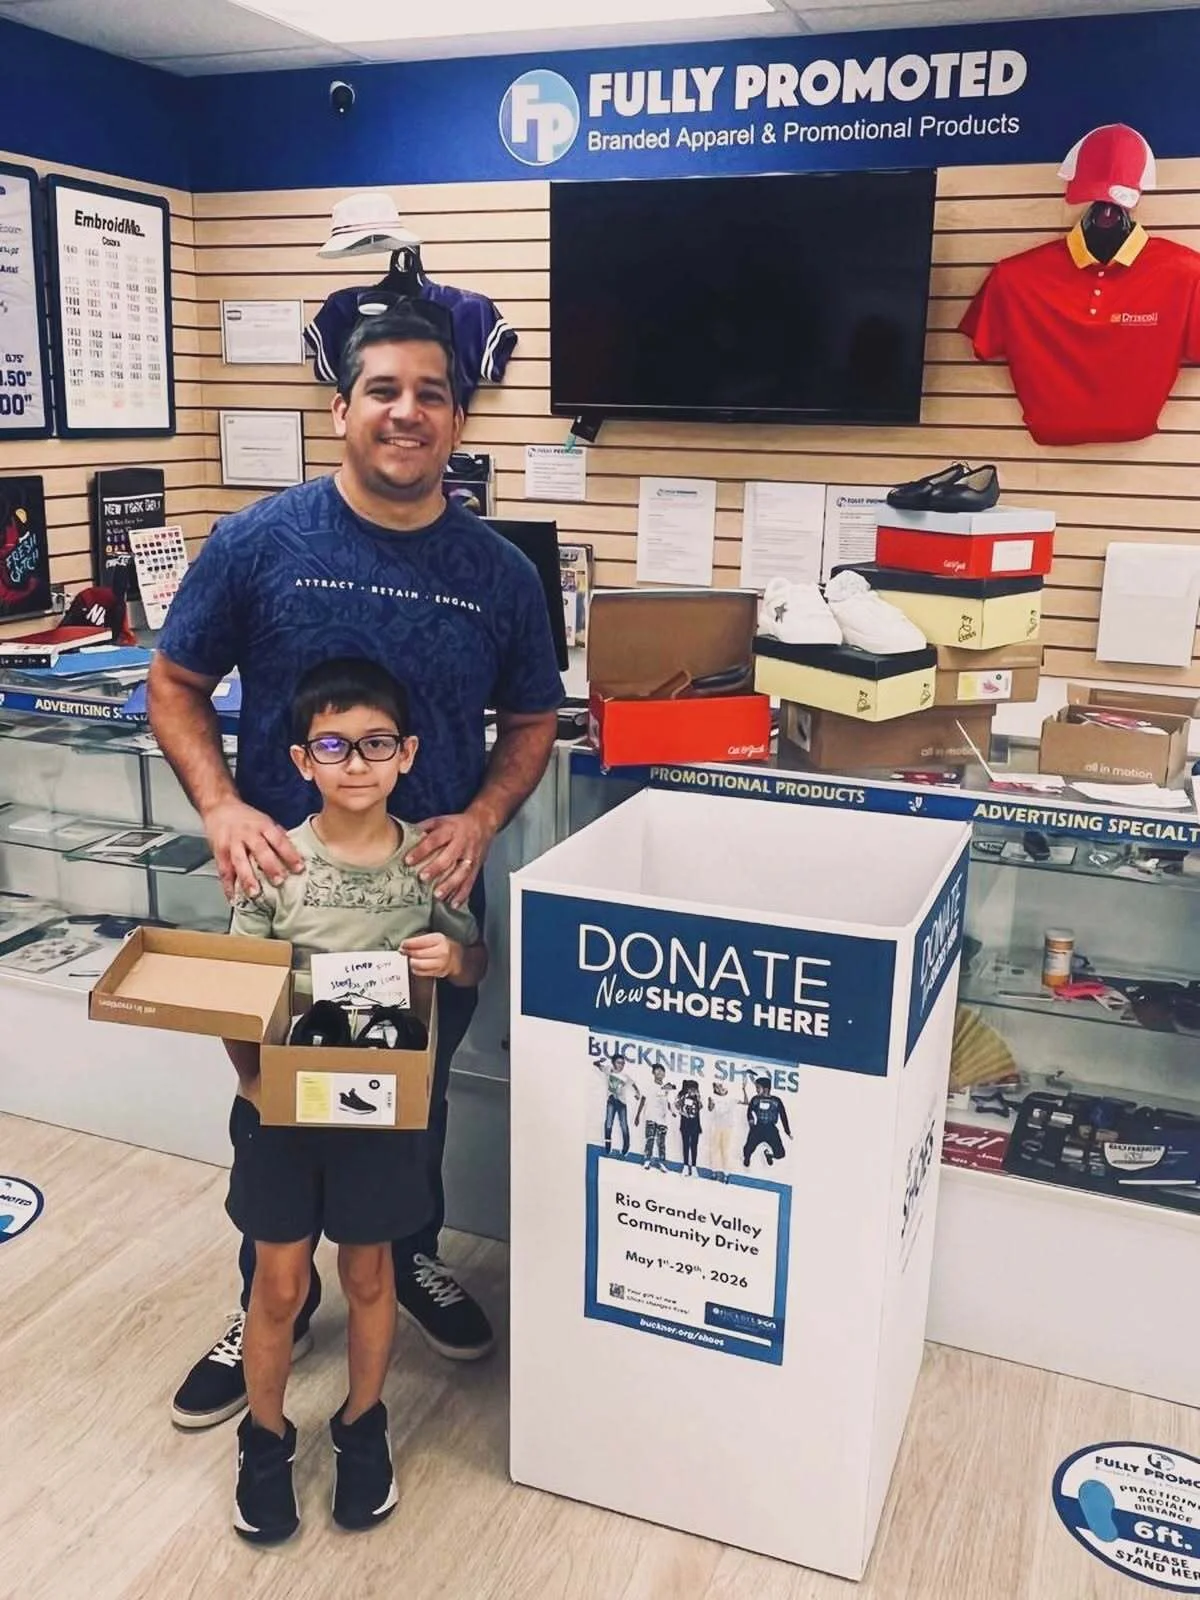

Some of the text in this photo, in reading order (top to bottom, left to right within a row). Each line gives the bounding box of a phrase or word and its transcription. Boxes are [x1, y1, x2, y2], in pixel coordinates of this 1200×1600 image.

[589, 50, 1027, 117] FULLY PROMOTED
[511, 84, 577, 162] FP
[588, 113, 1020, 152] Branded Apparel & Promotional Products
[296, 578, 354, 590] ATTRACT
[371, 585, 418, 599] RETAIN
[35, 698, 110, 719] ADVERTISING
[650, 766, 865, 804] PROMOTIONAL PRODUCTS
[1086, 762, 1153, 779] all in motion
[973, 803, 1103, 831] ADVERTISING
[578, 923, 832, 1008] DONATE
[595, 973, 829, 1037] New SHOES HERE
[588, 1035, 800, 1093] BUCKNER SHOES
[615, 1192, 762, 1239] Rio Grande Valley
[617, 1212, 759, 1256] Community Drive
[625, 1250, 654, 1269] May
[710, 1270, 748, 1289] 2026
[640, 1317, 725, 1347] buckner.org/shoes
[1095, 1456, 1140, 1473] FULLY
[1119, 1485, 1200, 1511] PRACTICIN
[1137, 1495, 1185, 1512] SOCIAL
[1134, 1503, 1193, 1524] DISTANCE
[1134, 1521, 1193, 1550] 6ft.
[1115, 1550, 1166, 1573] STAND
[1135, 1546, 1189, 1569] PLEASE
